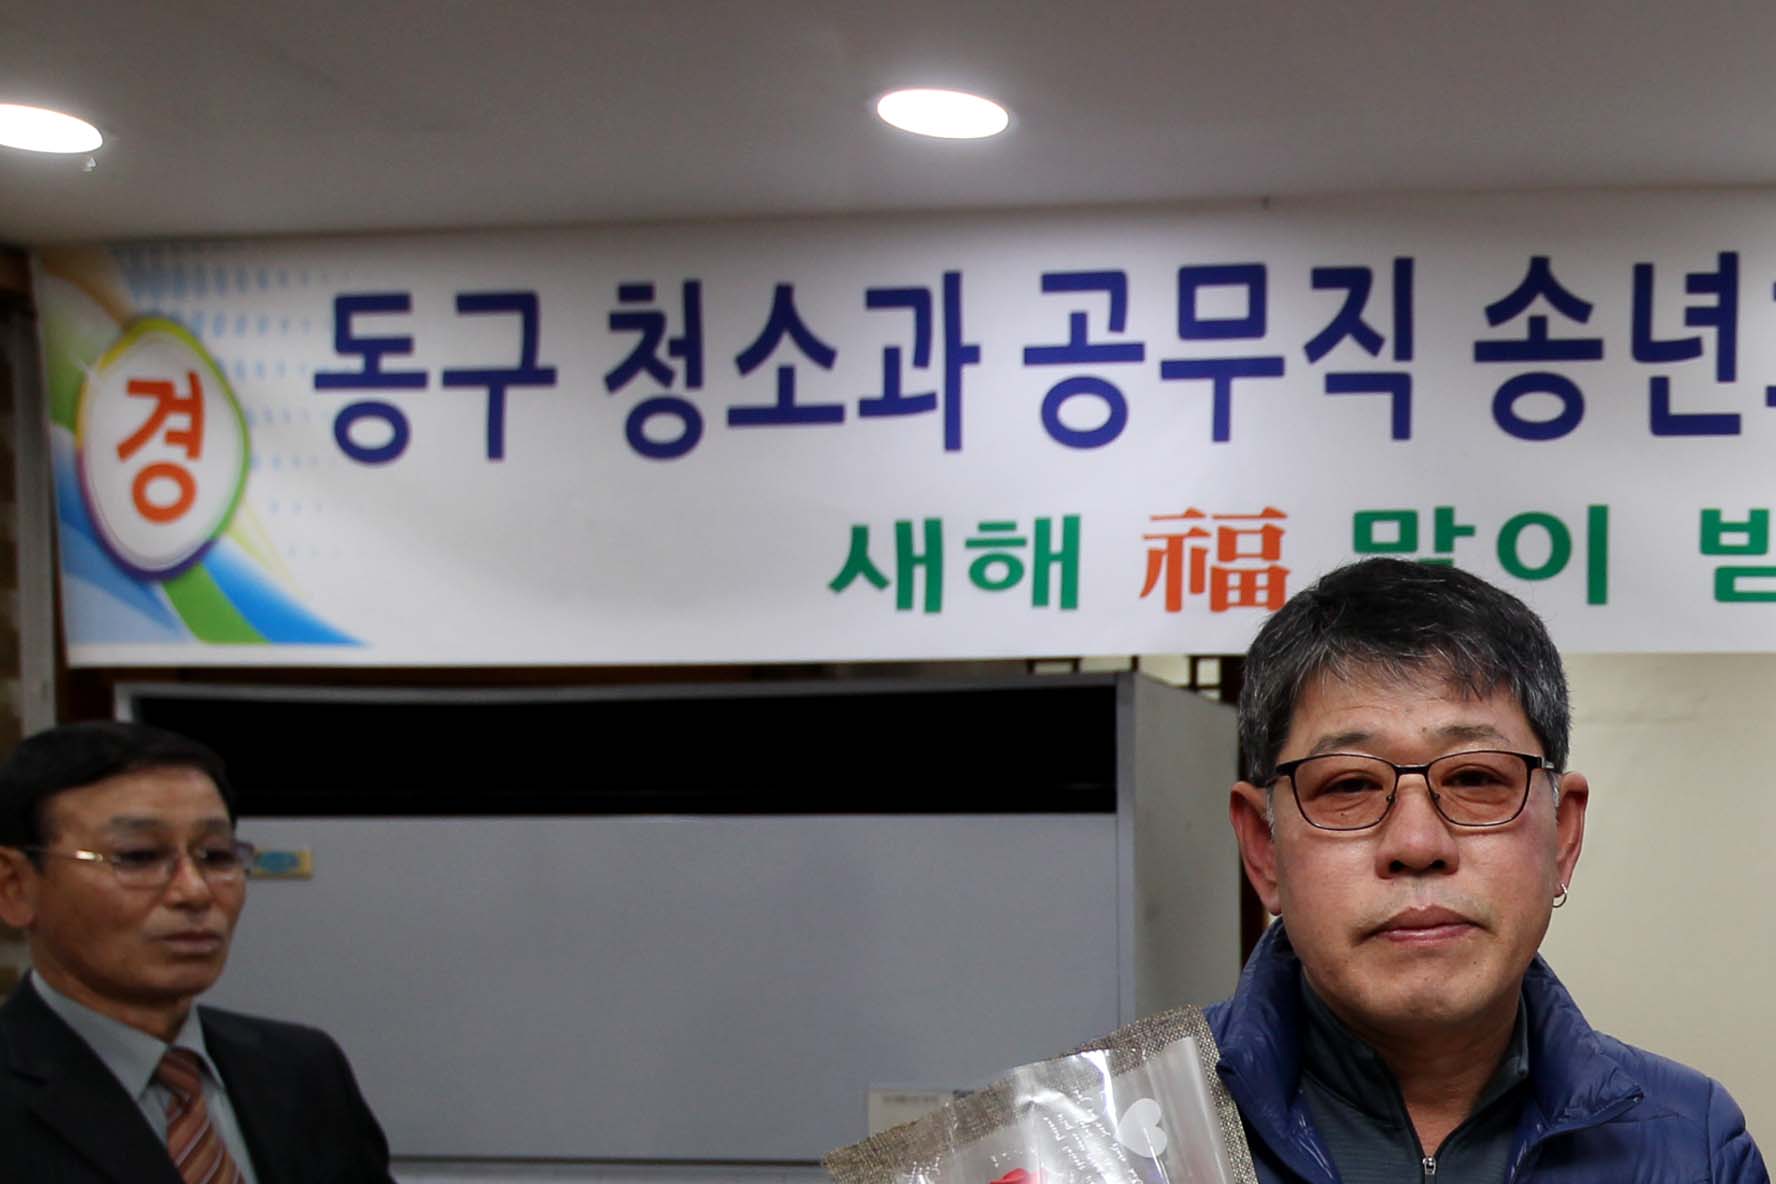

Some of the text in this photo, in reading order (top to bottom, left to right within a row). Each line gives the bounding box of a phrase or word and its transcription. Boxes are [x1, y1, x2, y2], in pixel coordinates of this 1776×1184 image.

[314, 291, 557, 464] 동구
[604, 271, 981, 459] 청소과
[1023, 257, 1413, 450] 공무직
[117, 370, 202, 524] 경
[829, 515, 1080, 612] 새해
[1140, 507, 1289, 613] 福
